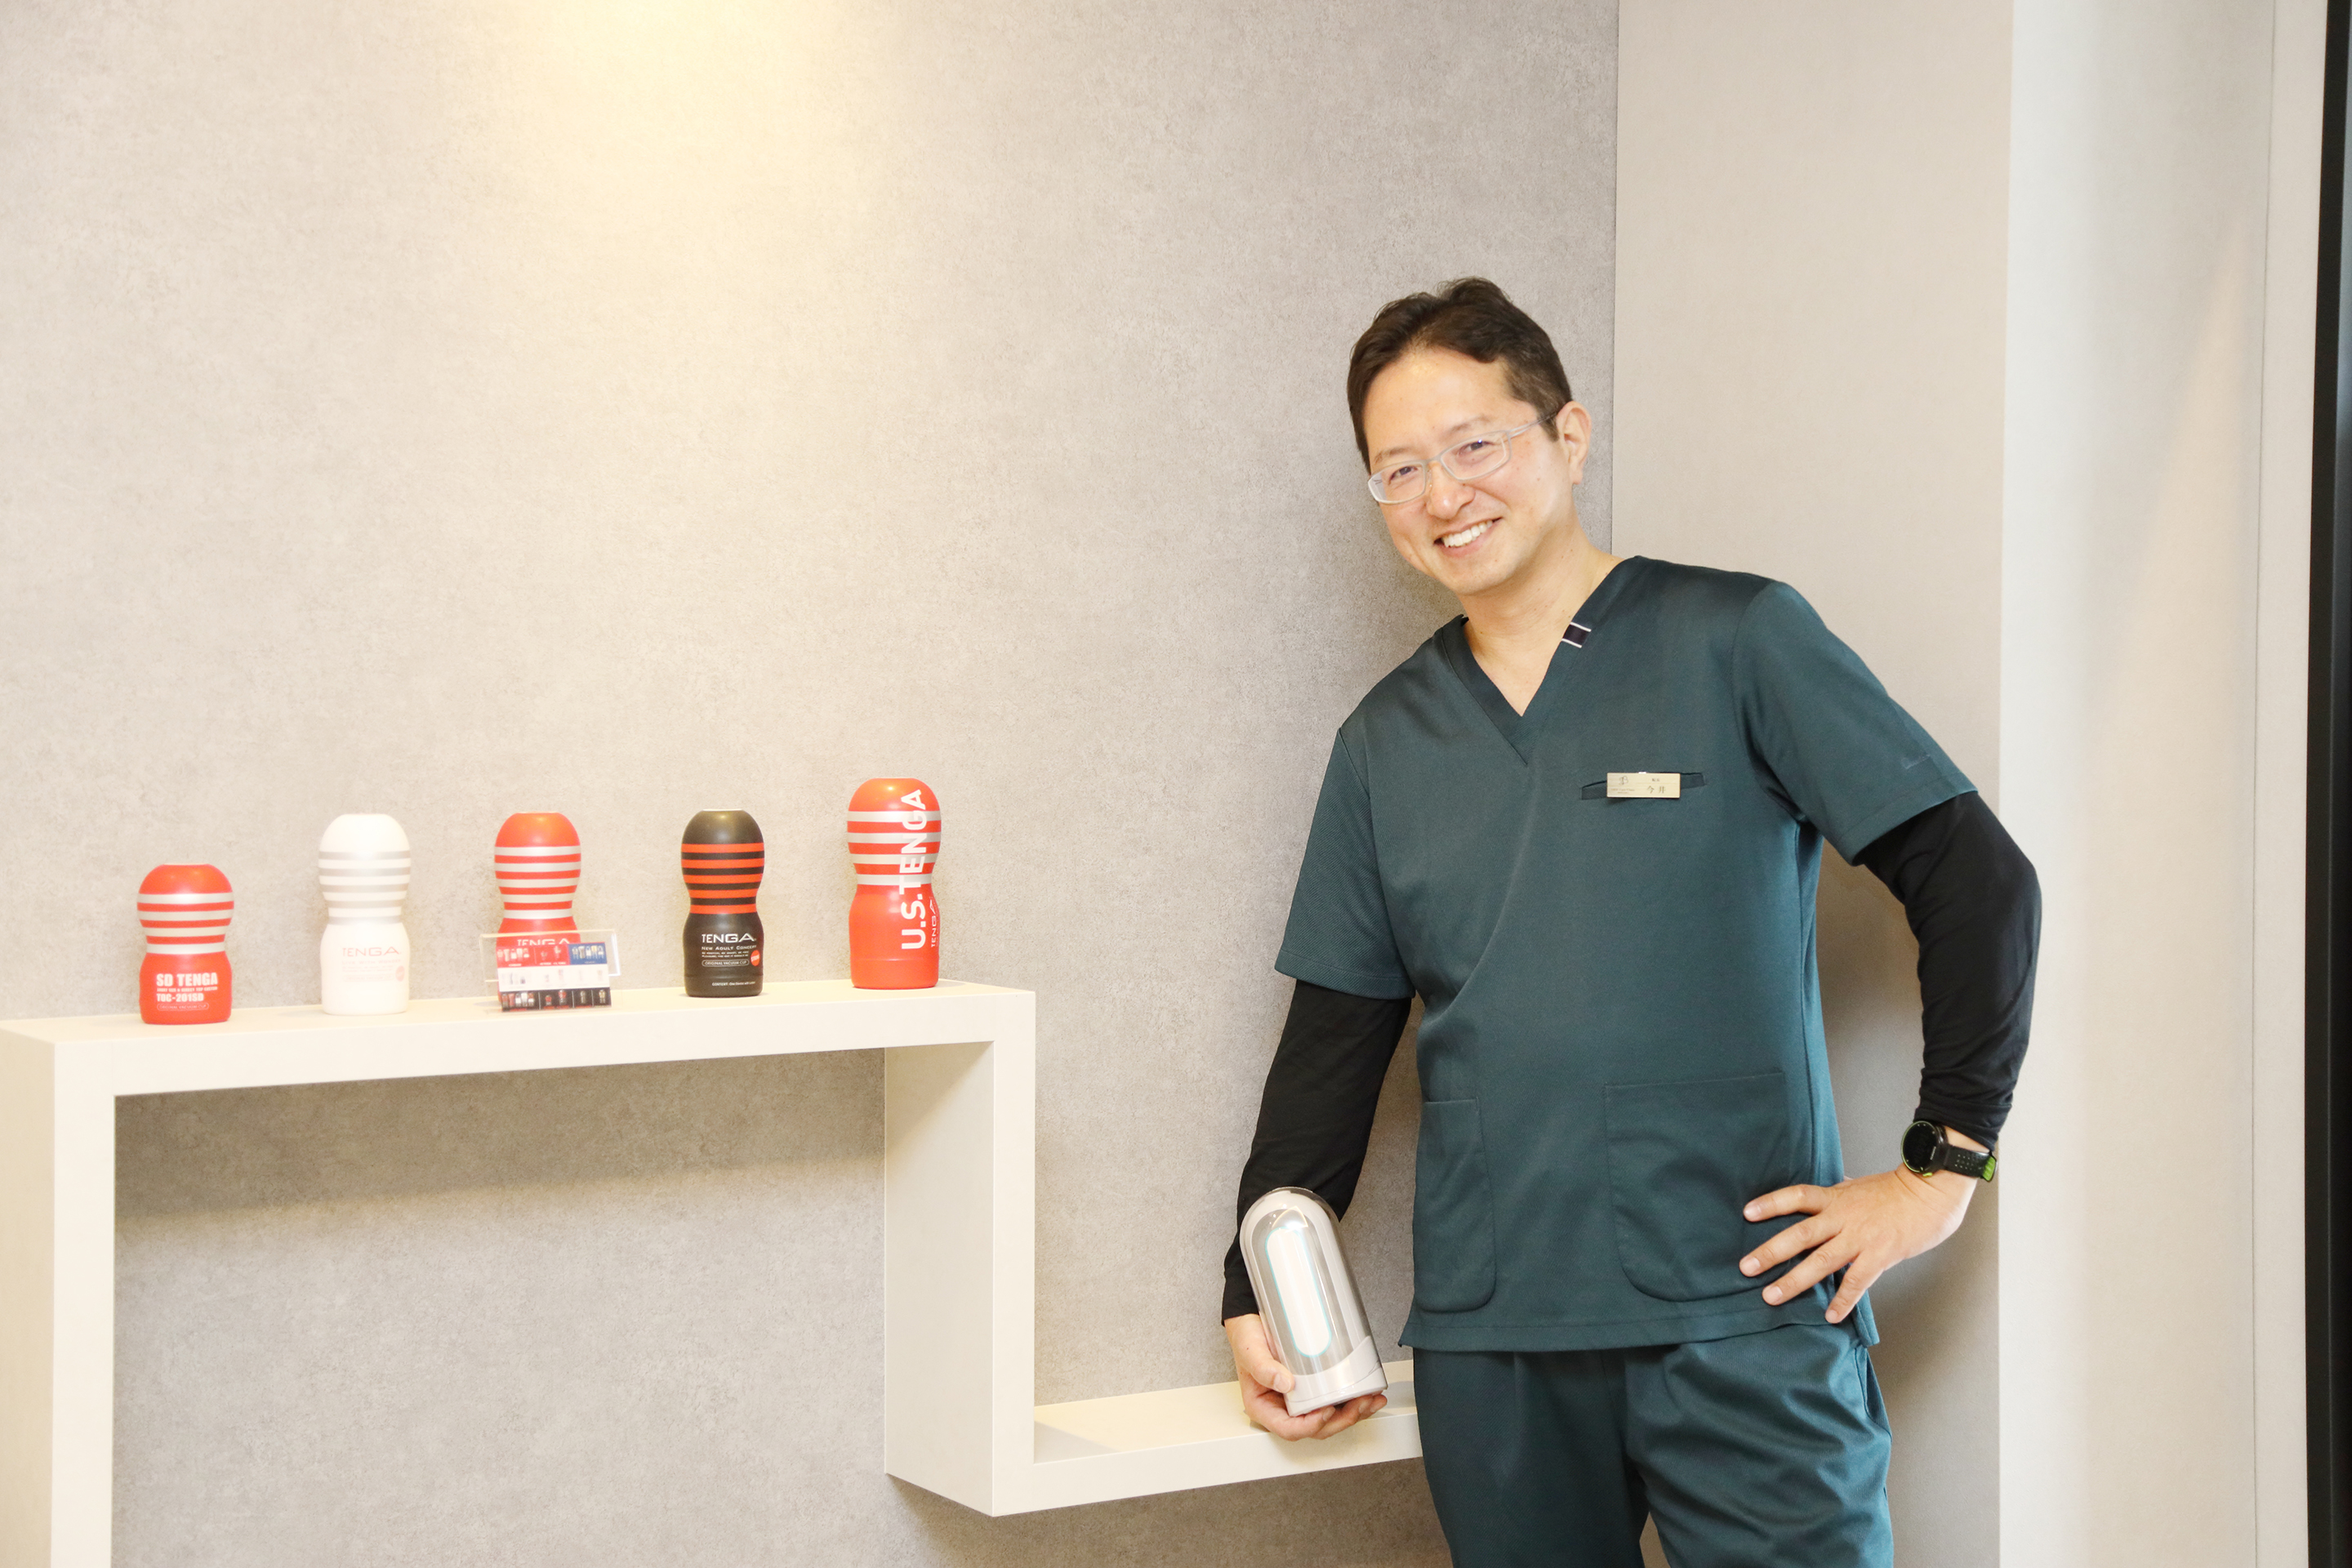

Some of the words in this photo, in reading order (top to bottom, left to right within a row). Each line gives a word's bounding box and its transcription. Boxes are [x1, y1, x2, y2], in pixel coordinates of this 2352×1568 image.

[702, 933, 755, 943] TENGA
[342, 946, 399, 957] TENGA
[156, 973, 173, 987] SD
[176, 973, 218, 987] TENGA
[156, 993, 204, 1002] TOC-201SD
